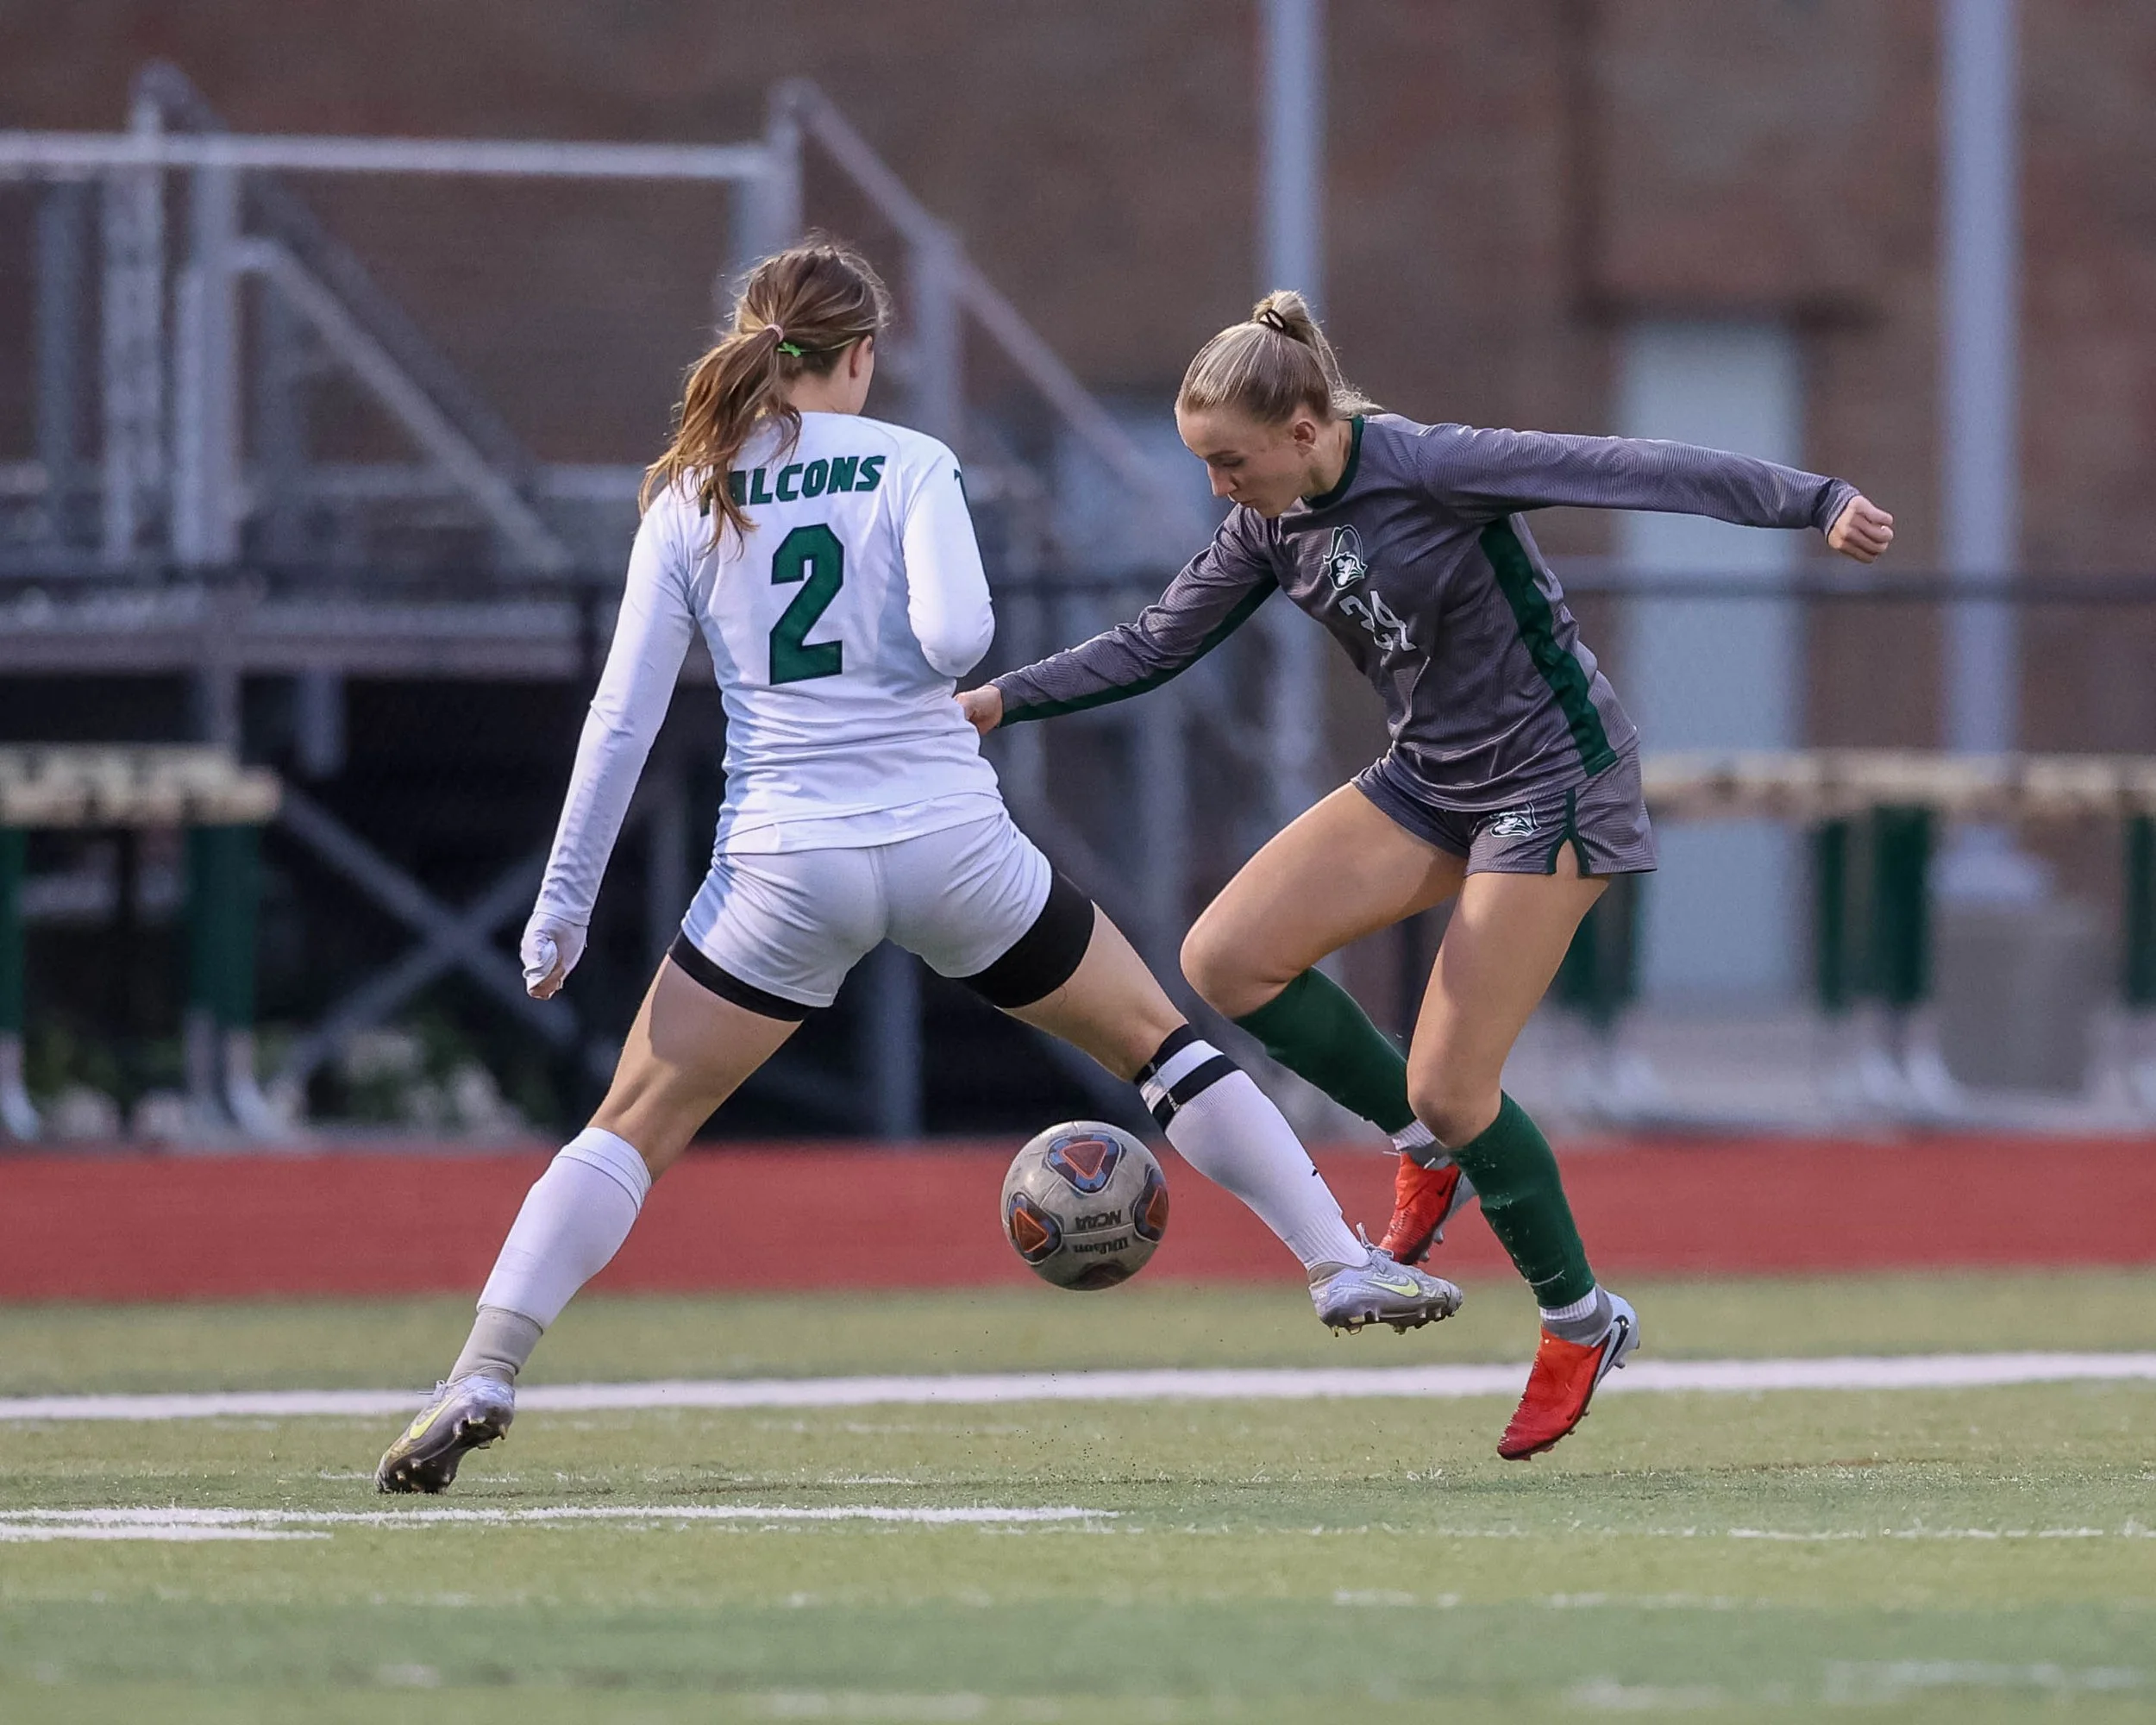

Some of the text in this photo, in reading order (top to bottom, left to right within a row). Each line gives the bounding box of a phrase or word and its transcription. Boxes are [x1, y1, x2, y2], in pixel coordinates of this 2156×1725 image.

[770, 524, 844, 685] 2
[1075, 1209, 1121, 1230] NCAA
[1075, 1238, 1129, 1254] Wilson
